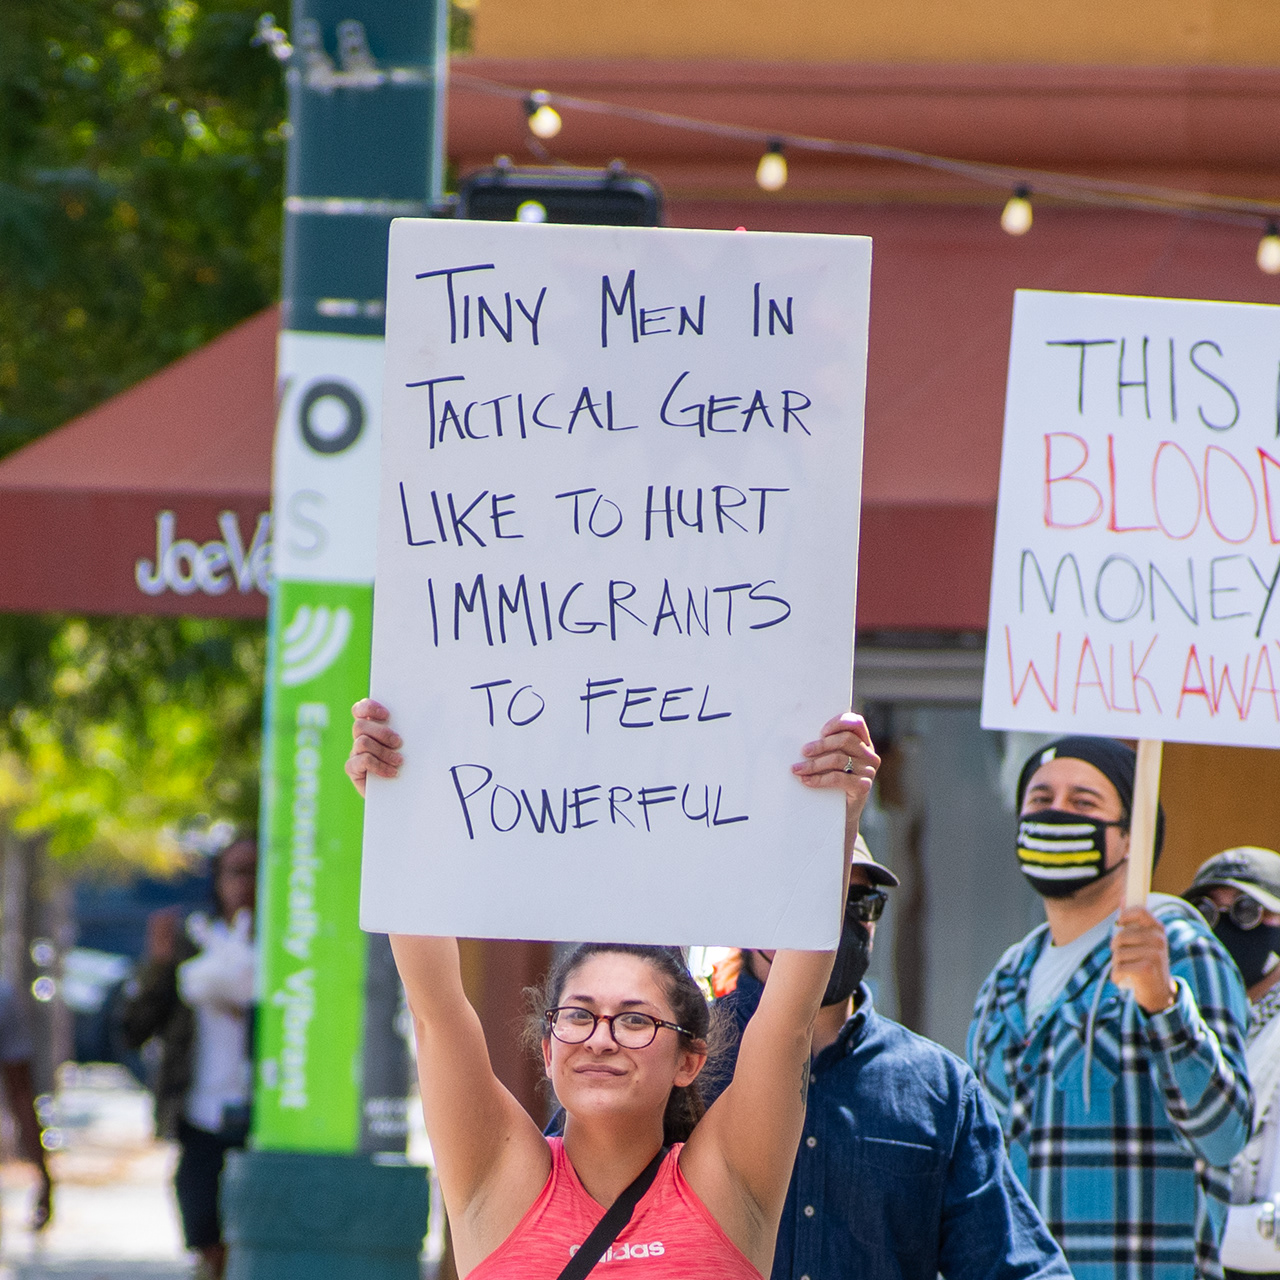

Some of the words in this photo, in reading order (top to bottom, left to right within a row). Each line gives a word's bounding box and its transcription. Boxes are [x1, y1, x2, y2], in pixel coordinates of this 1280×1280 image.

[415, 263, 548, 346] TINY
[601, 269, 706, 349] MEN
[753, 282, 794, 338] IN
[405, 375, 639, 450] TACTICAL
[659, 370, 812, 438] GEAR
[1045, 335, 1240, 432] THIS
[399, 481, 525, 548] LIKE
[554, 487, 623, 538] TO
[644, 485, 790, 542] HURT
[427, 573, 792, 648] IMMIGRANTS
[470, 679, 545, 727] TO
[579, 677, 732, 735] FEEL
[1005, 626, 1162, 714] WALK
[283, 702, 329, 959] Economically
[448, 763, 750, 840] POWERFUL
[569, 1241, 666, 1263] idas
